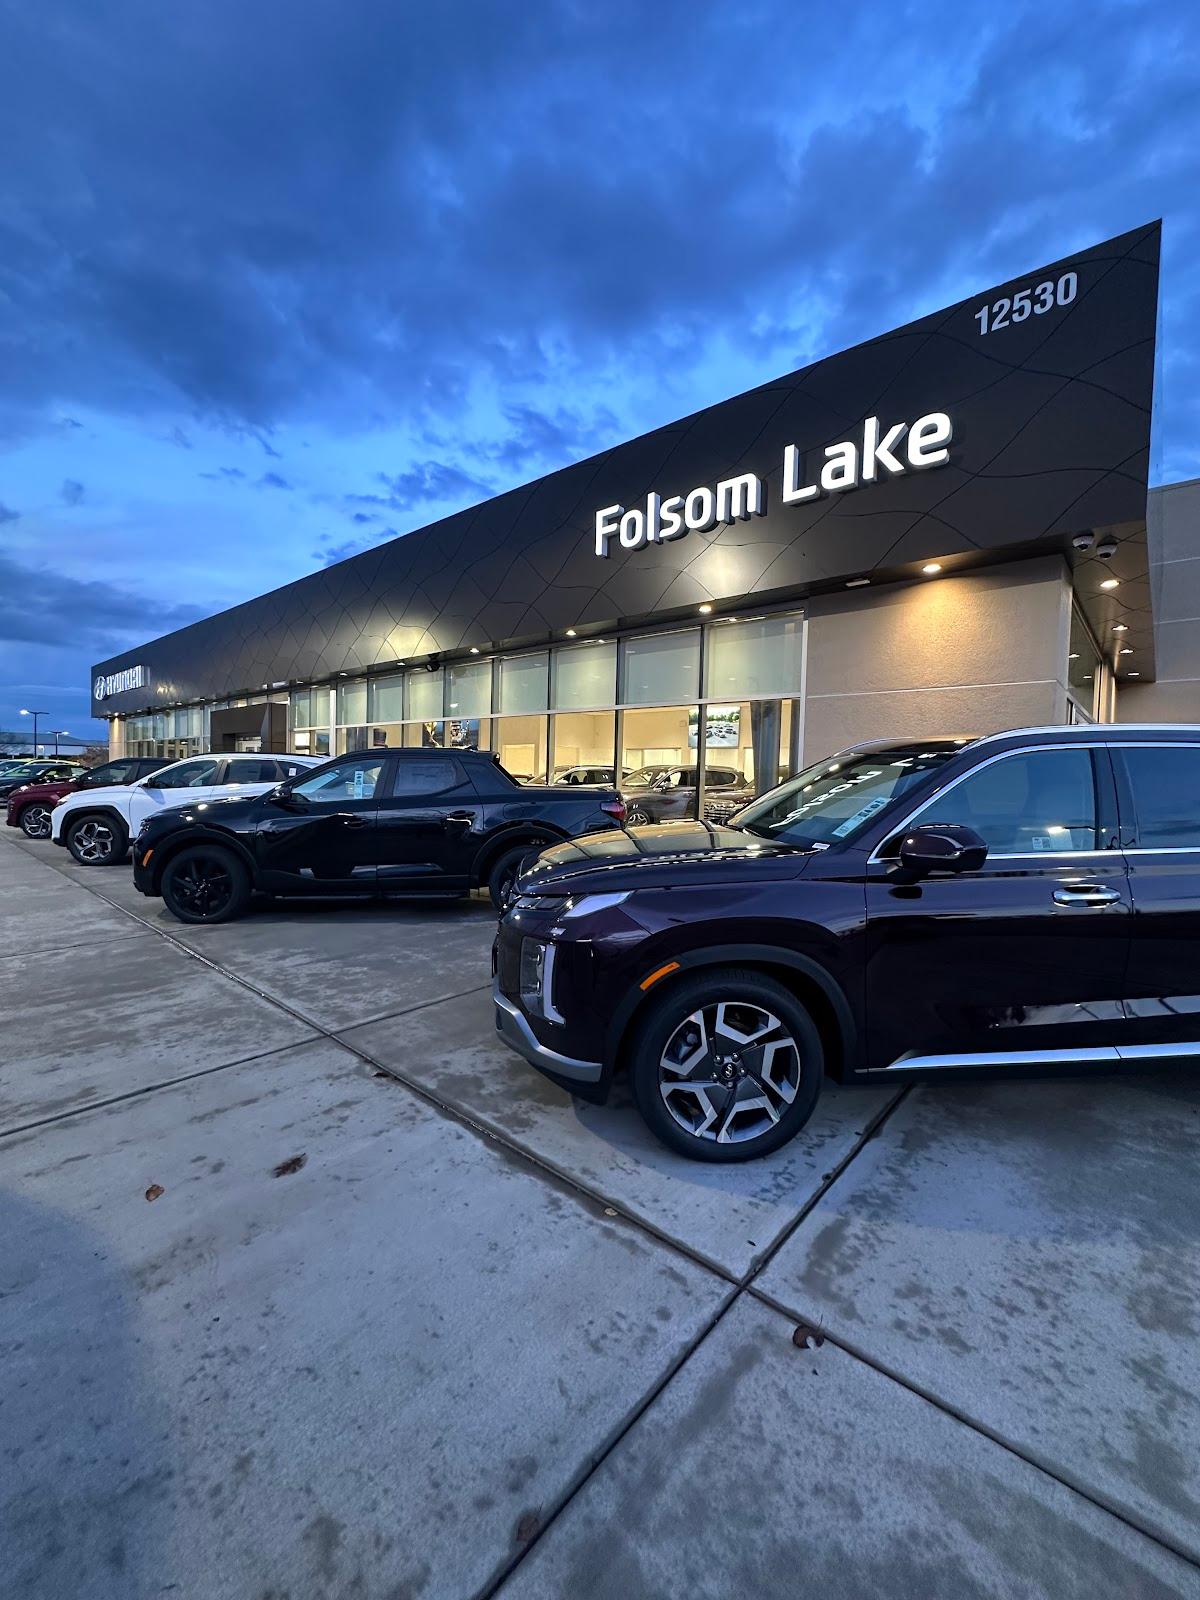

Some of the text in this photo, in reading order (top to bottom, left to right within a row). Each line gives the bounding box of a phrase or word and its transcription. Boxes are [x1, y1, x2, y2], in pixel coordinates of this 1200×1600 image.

[974, 271, 1078, 336] 12530
[594, 411, 952, 558] Folsom Lake
[106, 665, 144, 696] HYUNDAI
